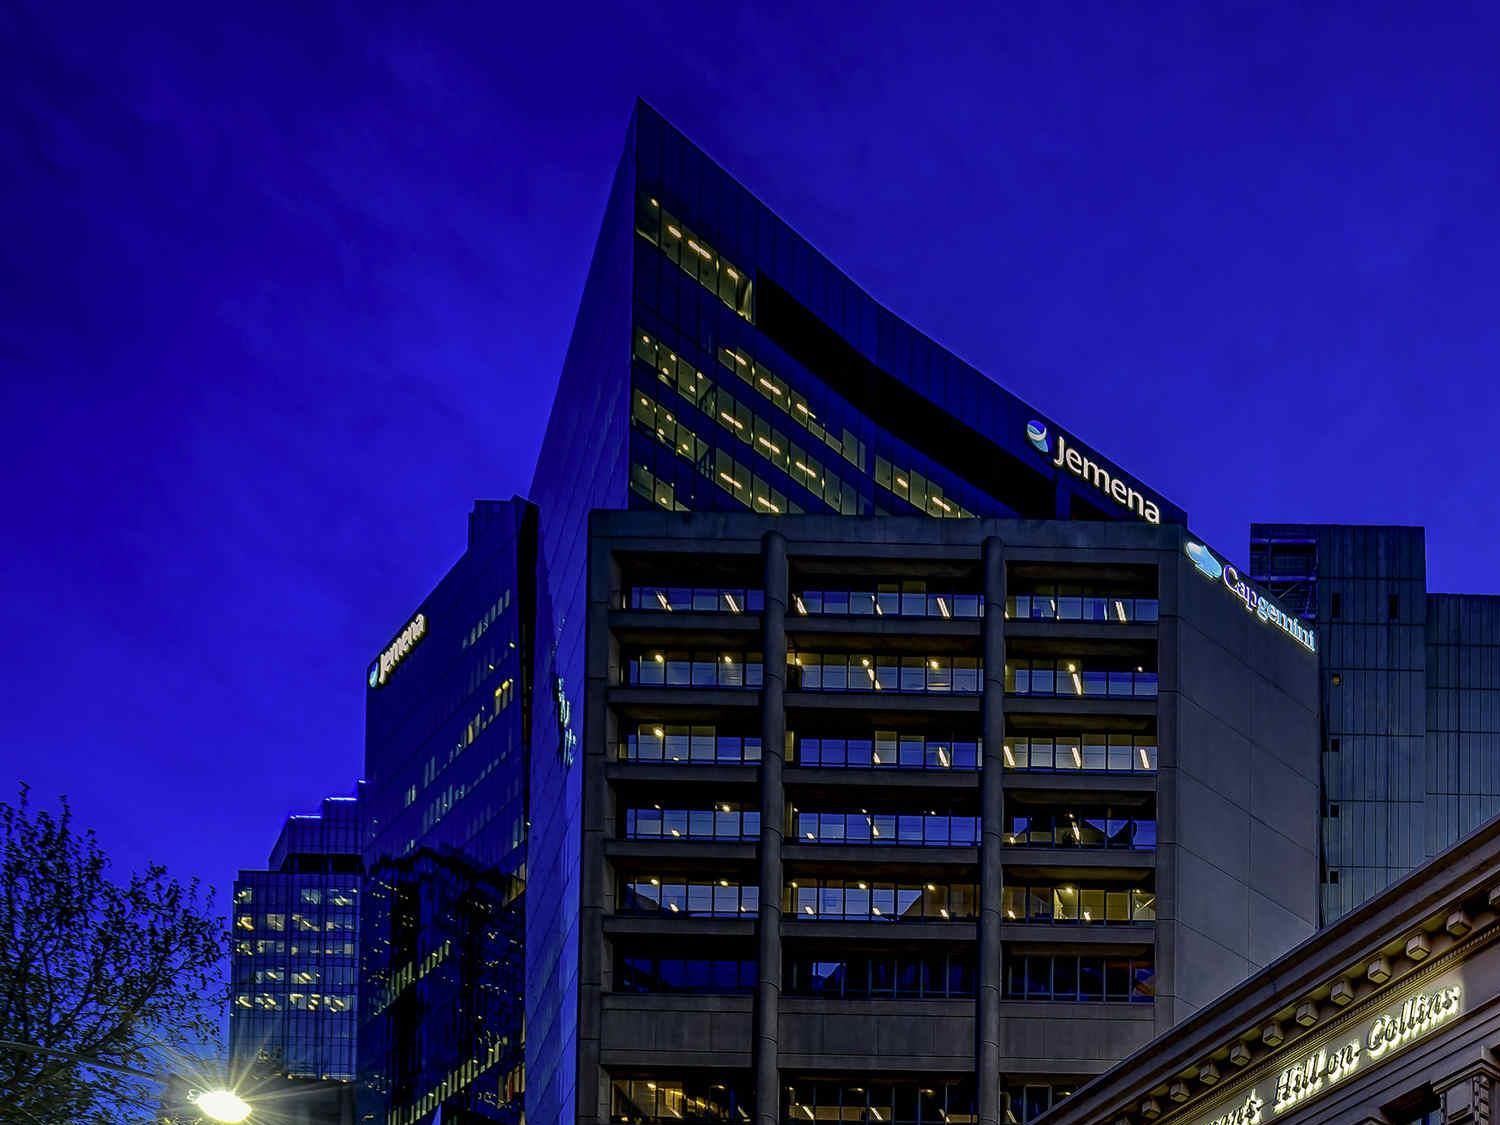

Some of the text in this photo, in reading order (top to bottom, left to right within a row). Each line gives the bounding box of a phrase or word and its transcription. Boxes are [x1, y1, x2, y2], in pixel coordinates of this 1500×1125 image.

[1054, 436, 1160, 525] Jemena
[379, 613, 426, 684] Jemena
[1223, 564, 1316, 651] Capgemini
[1272, 1055, 1323, 1106] Hill
[1326, 1042, 1362, 1076] on
[1367, 985, 1461, 1053] Collins
